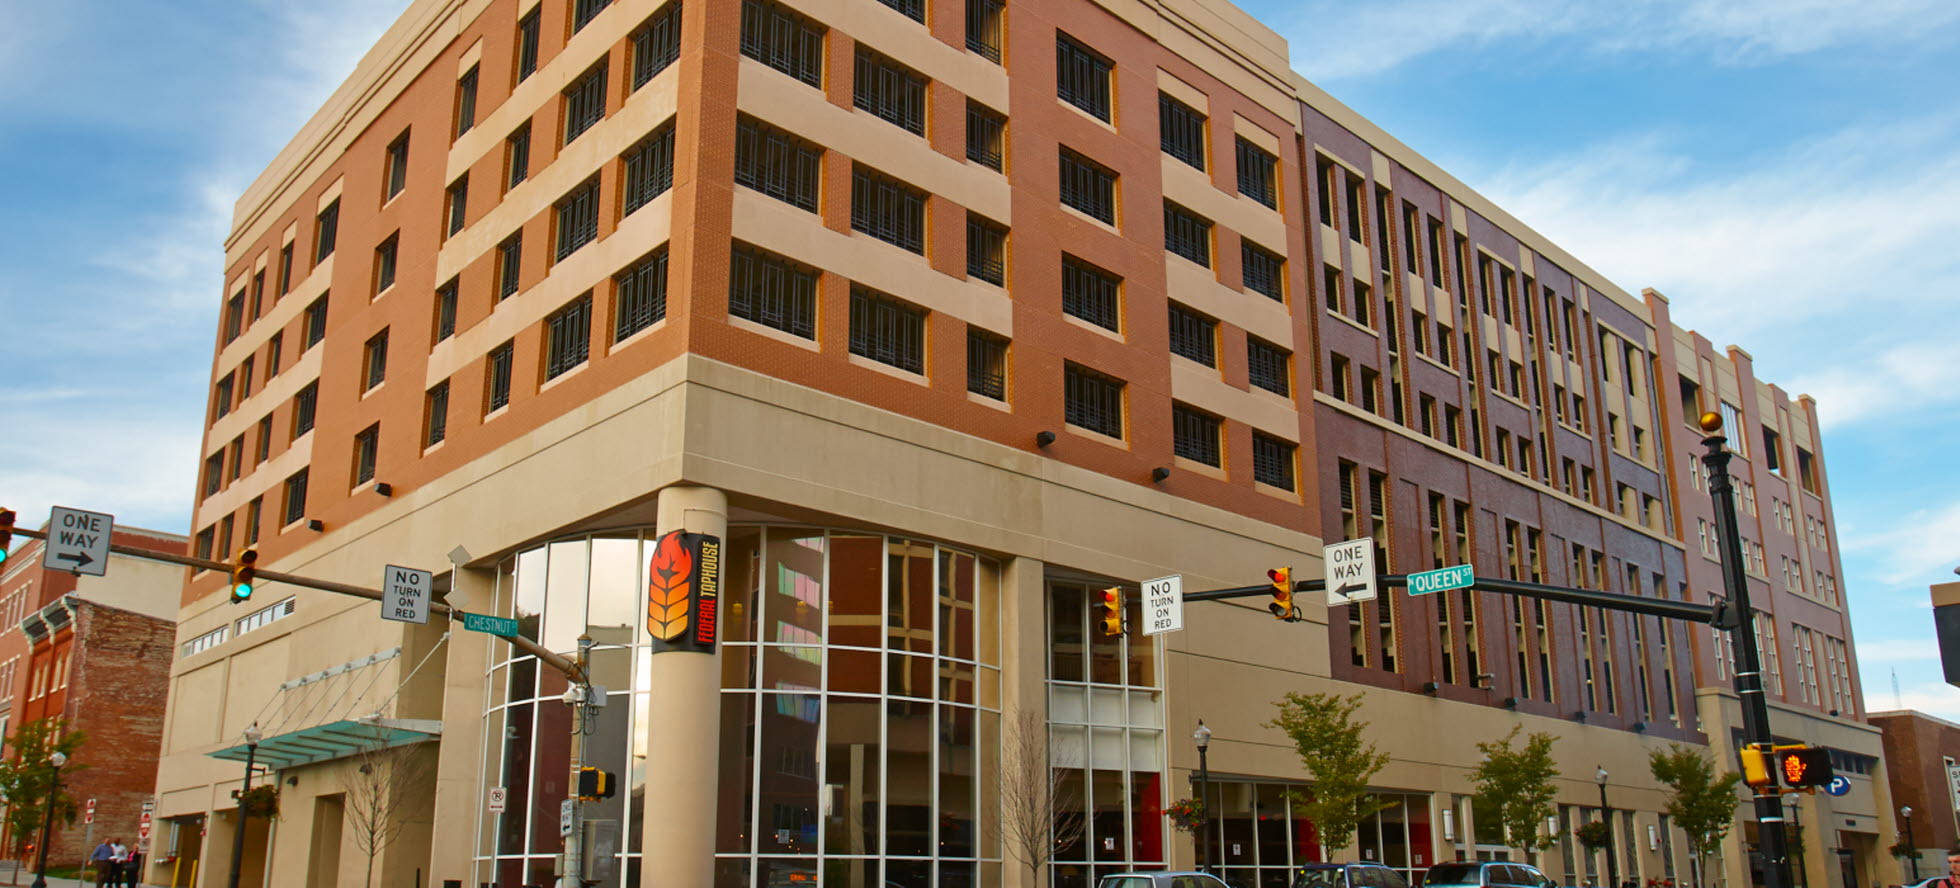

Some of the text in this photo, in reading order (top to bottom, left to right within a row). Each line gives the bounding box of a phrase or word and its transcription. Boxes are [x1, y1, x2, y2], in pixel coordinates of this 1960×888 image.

[63, 513, 101, 532] ONE
[60, 530, 99, 549] WAY
[1333, 545, 1363, 563] ONE
[395, 570, 420, 586] NO
[1333, 562, 1363, 580] WAY
[1415, 569, 1463, 592] QUEEN
[1462, 567, 1472, 577] ST
[393, 585, 421, 598] TURN
[697, 541, 719, 643] FEDERAL TAPHOUSE
[1150, 581, 1171, 597] NO
[398, 597, 414, 608] ON
[1150, 595, 1174, 608] TURN
[395, 607, 416, 619] RED
[1156, 608, 1169, 619] ON
[468, 615, 511, 634] CHESTNUT
[1154, 618, 1172, 630] RED
